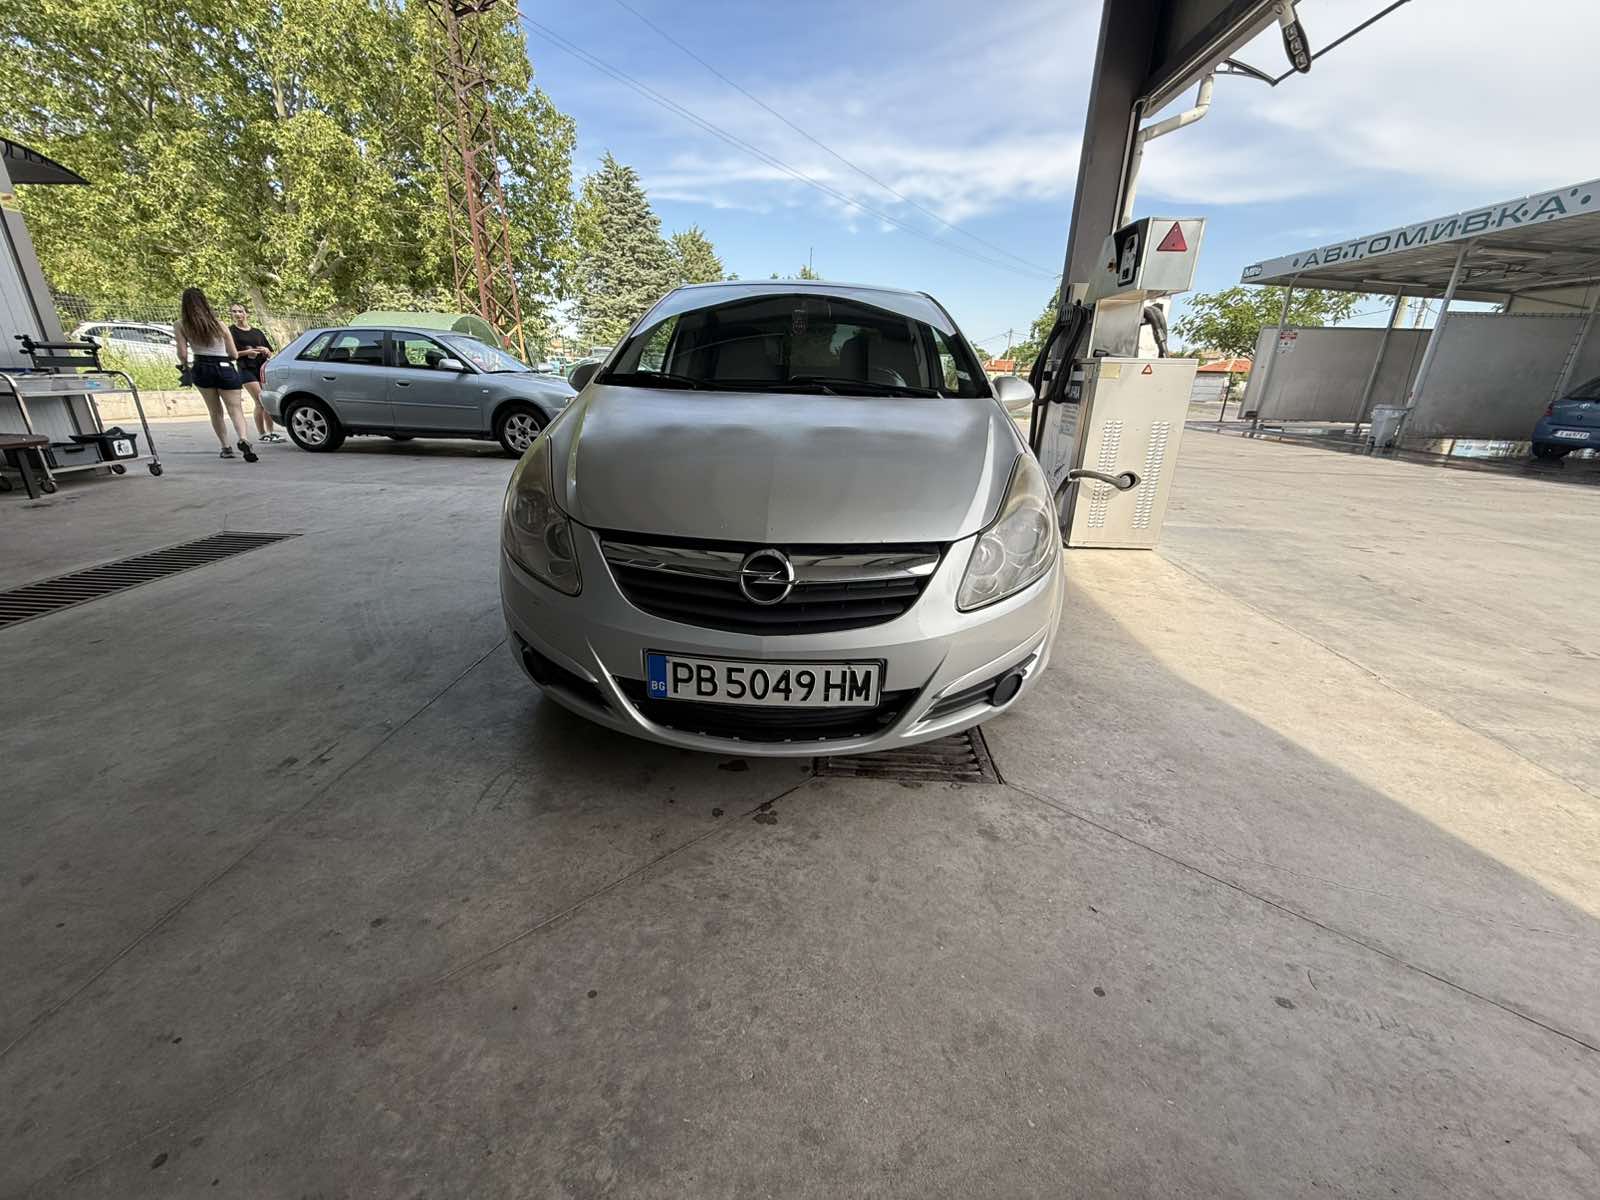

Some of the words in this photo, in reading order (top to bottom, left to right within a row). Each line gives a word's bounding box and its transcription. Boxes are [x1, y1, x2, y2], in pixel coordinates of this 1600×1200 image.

[1302, 196, 1567, 268] АВТОМИВКА
[651, 681, 665, 691] BG
[672, 662, 718, 696] PB
[726, 667, 816, 701] 5049
[823, 670, 872, 702] HM
